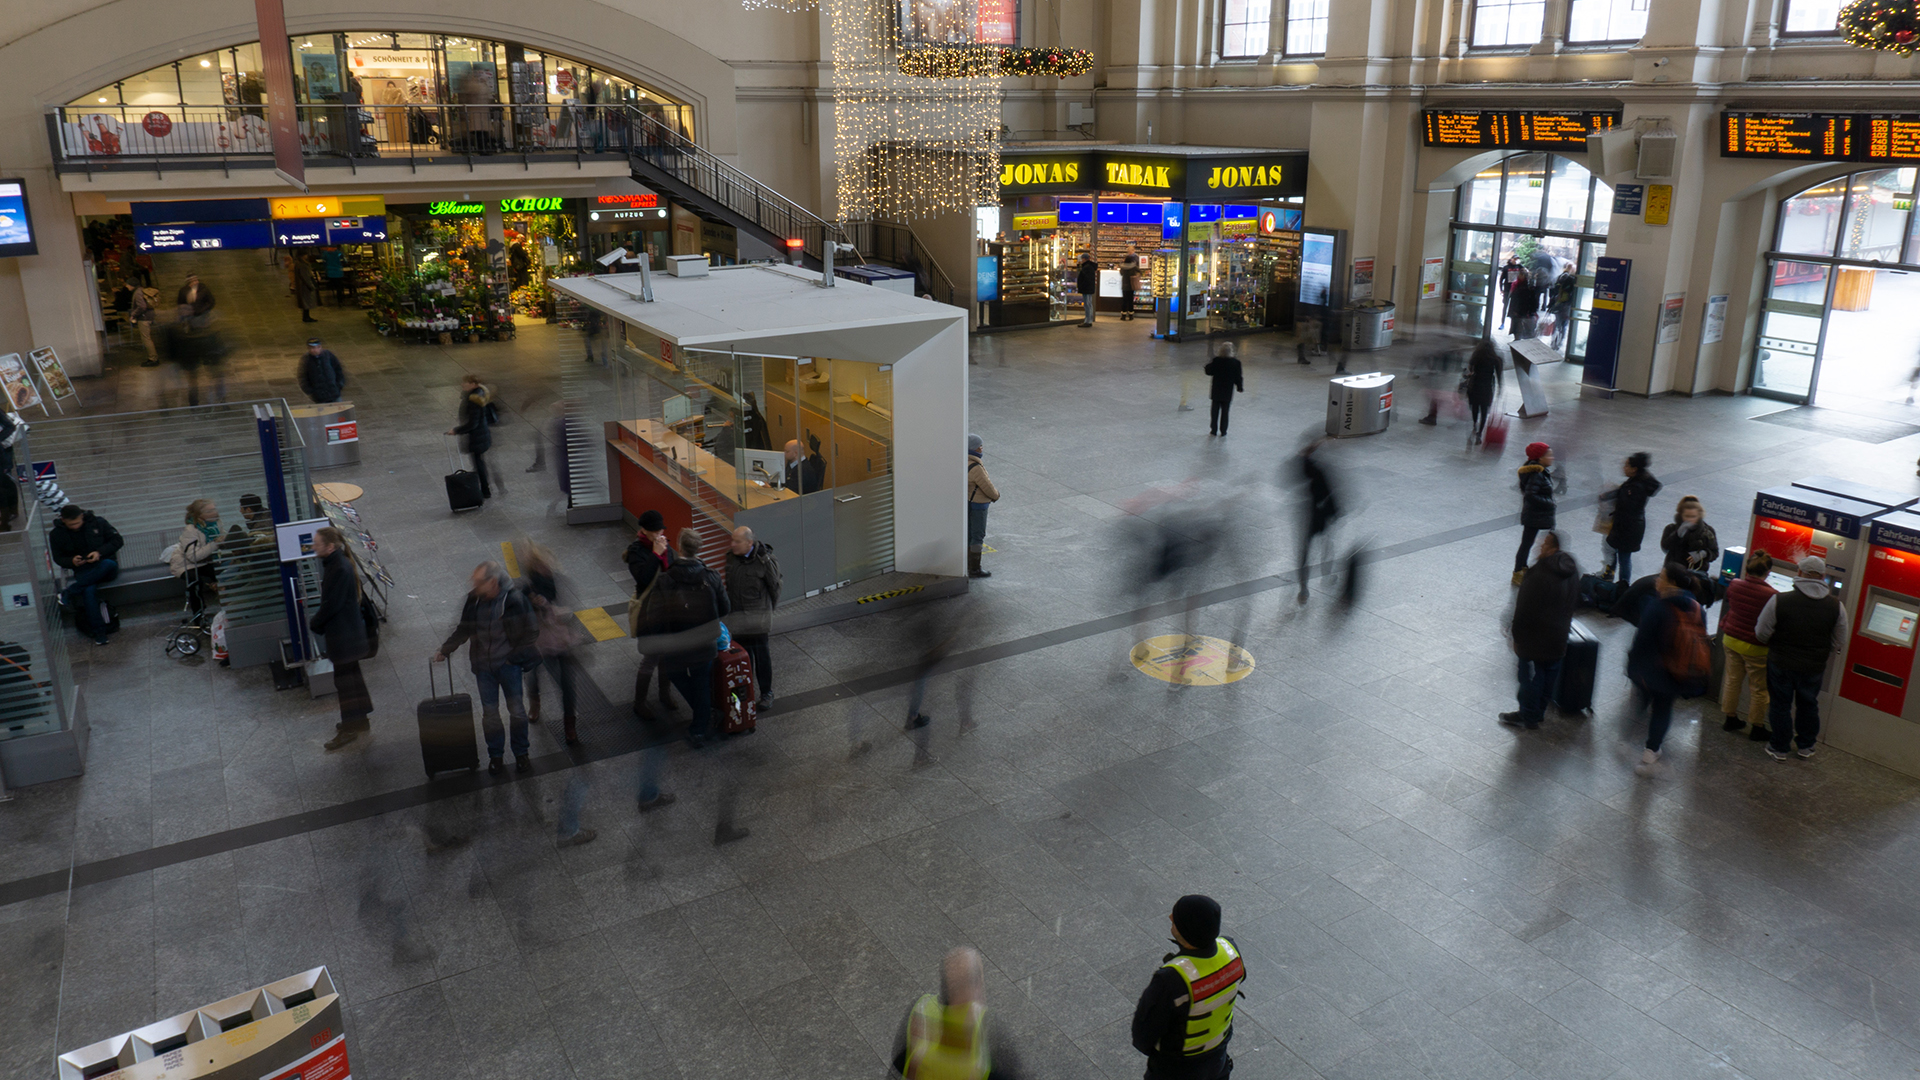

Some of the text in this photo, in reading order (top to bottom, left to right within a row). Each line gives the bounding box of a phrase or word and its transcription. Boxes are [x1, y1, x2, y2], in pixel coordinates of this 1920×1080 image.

[372, 54, 413, 63] SCHÖNHEIT
[1000, 162, 1078, 186] JONAS
[1106, 162, 1170, 188] TABAK
[1208, 165, 1282, 188] JONAS
[500, 198, 562, 212] SCHOR
[598, 194, 658, 204] ROSSMANN
[1231, 222, 1251, 231] LOTTO
[978, 271, 997, 279] DEINE
[660, 340, 672, 361] DB
[1344, 401, 1354, 430] Abfall
[1762, 499, 1807, 517] Fahrkarten
[1878, 526, 1920, 545] Fahrkarte
[312, 1029, 330, 1048] DB
[162, 1049, 182, 1060] PAPIER
[164, 1054, 182, 1064] PAPER
[164, 1058, 184, 1068] PAPIER
[166, 1062, 184, 1071] PAPEL
